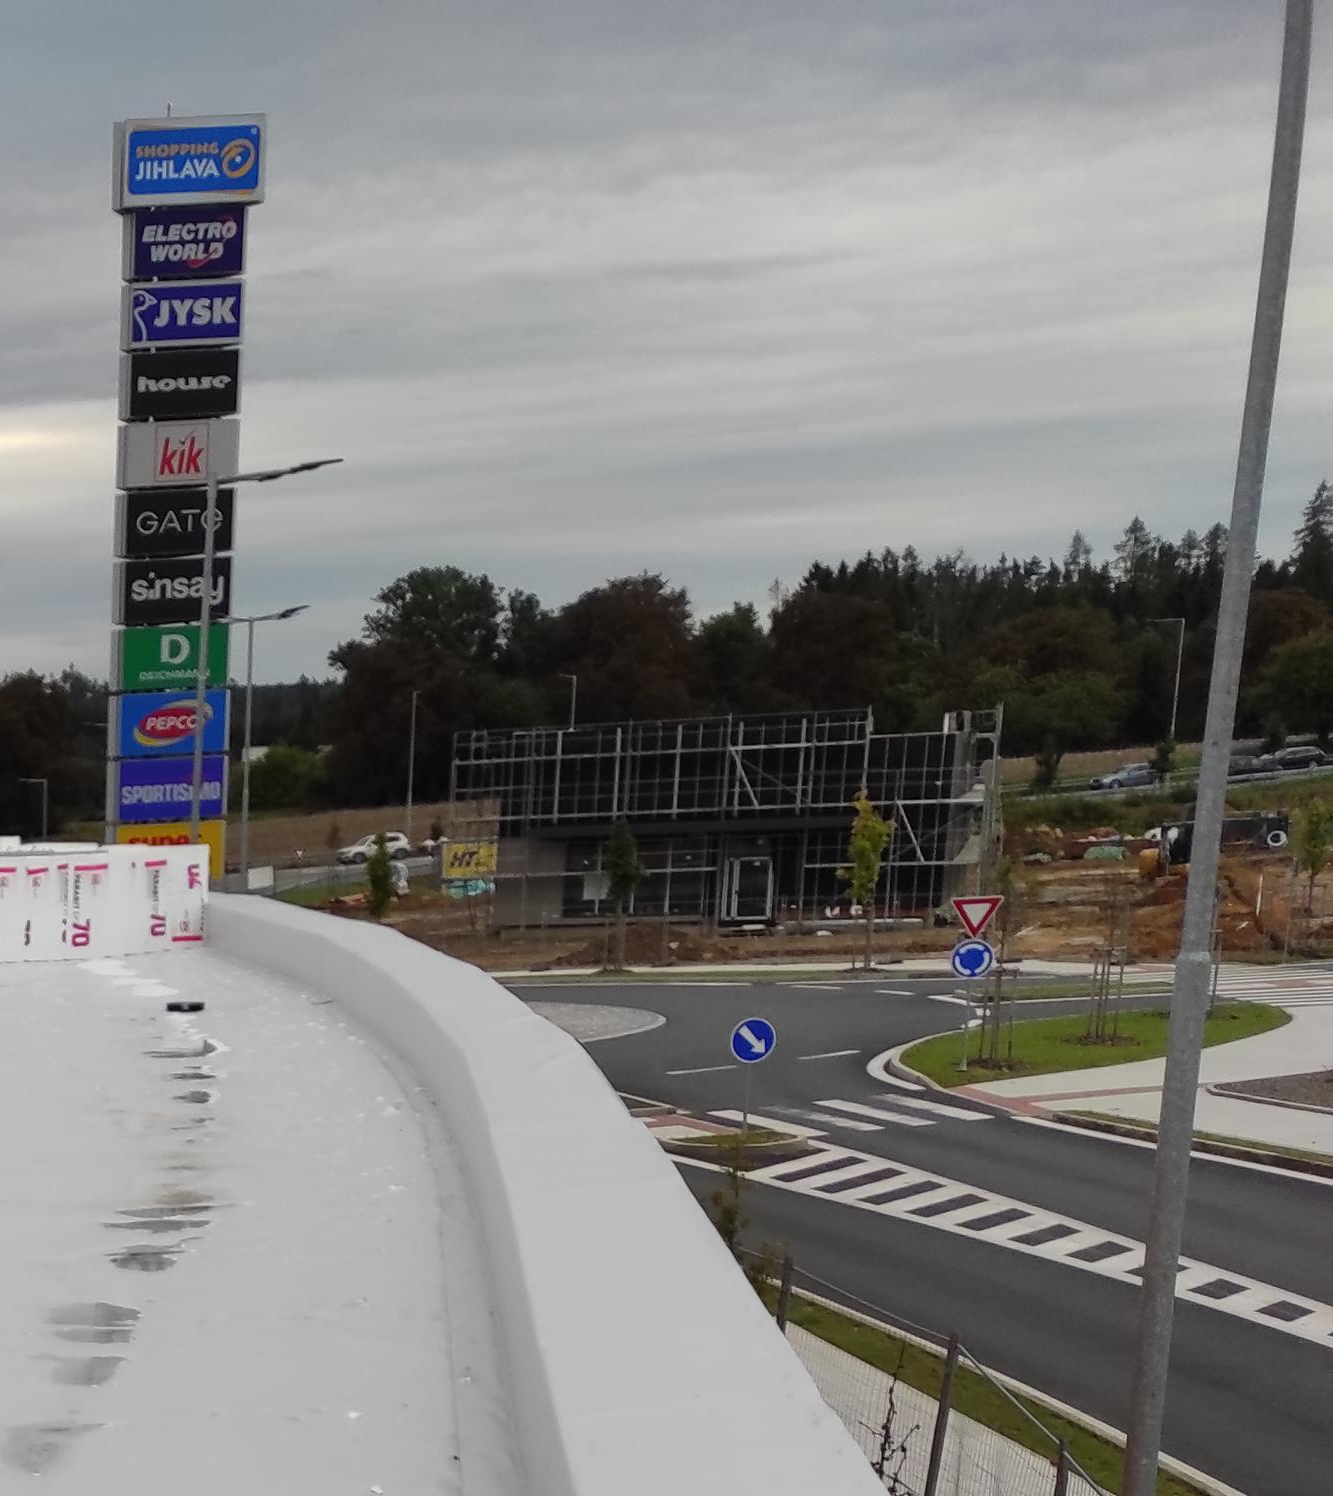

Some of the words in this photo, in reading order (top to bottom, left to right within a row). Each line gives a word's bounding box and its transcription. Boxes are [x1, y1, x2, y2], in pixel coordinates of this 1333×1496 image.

[136, 142, 219, 159] SHOPPING
[135, 159, 220, 180] JIHLAVA
[142, 221, 237, 243] ELECTRO
[150, 242, 225, 263] WORLD
[153, 296, 237, 327] JYSK
[137, 374, 232, 393] house
[159, 434, 205, 475] kik
[131, 571, 225, 605] sinsay
[160, 633, 191, 665] D
[145, 714, 200, 731] PEPCO
[72, 919, 91, 947] 70
